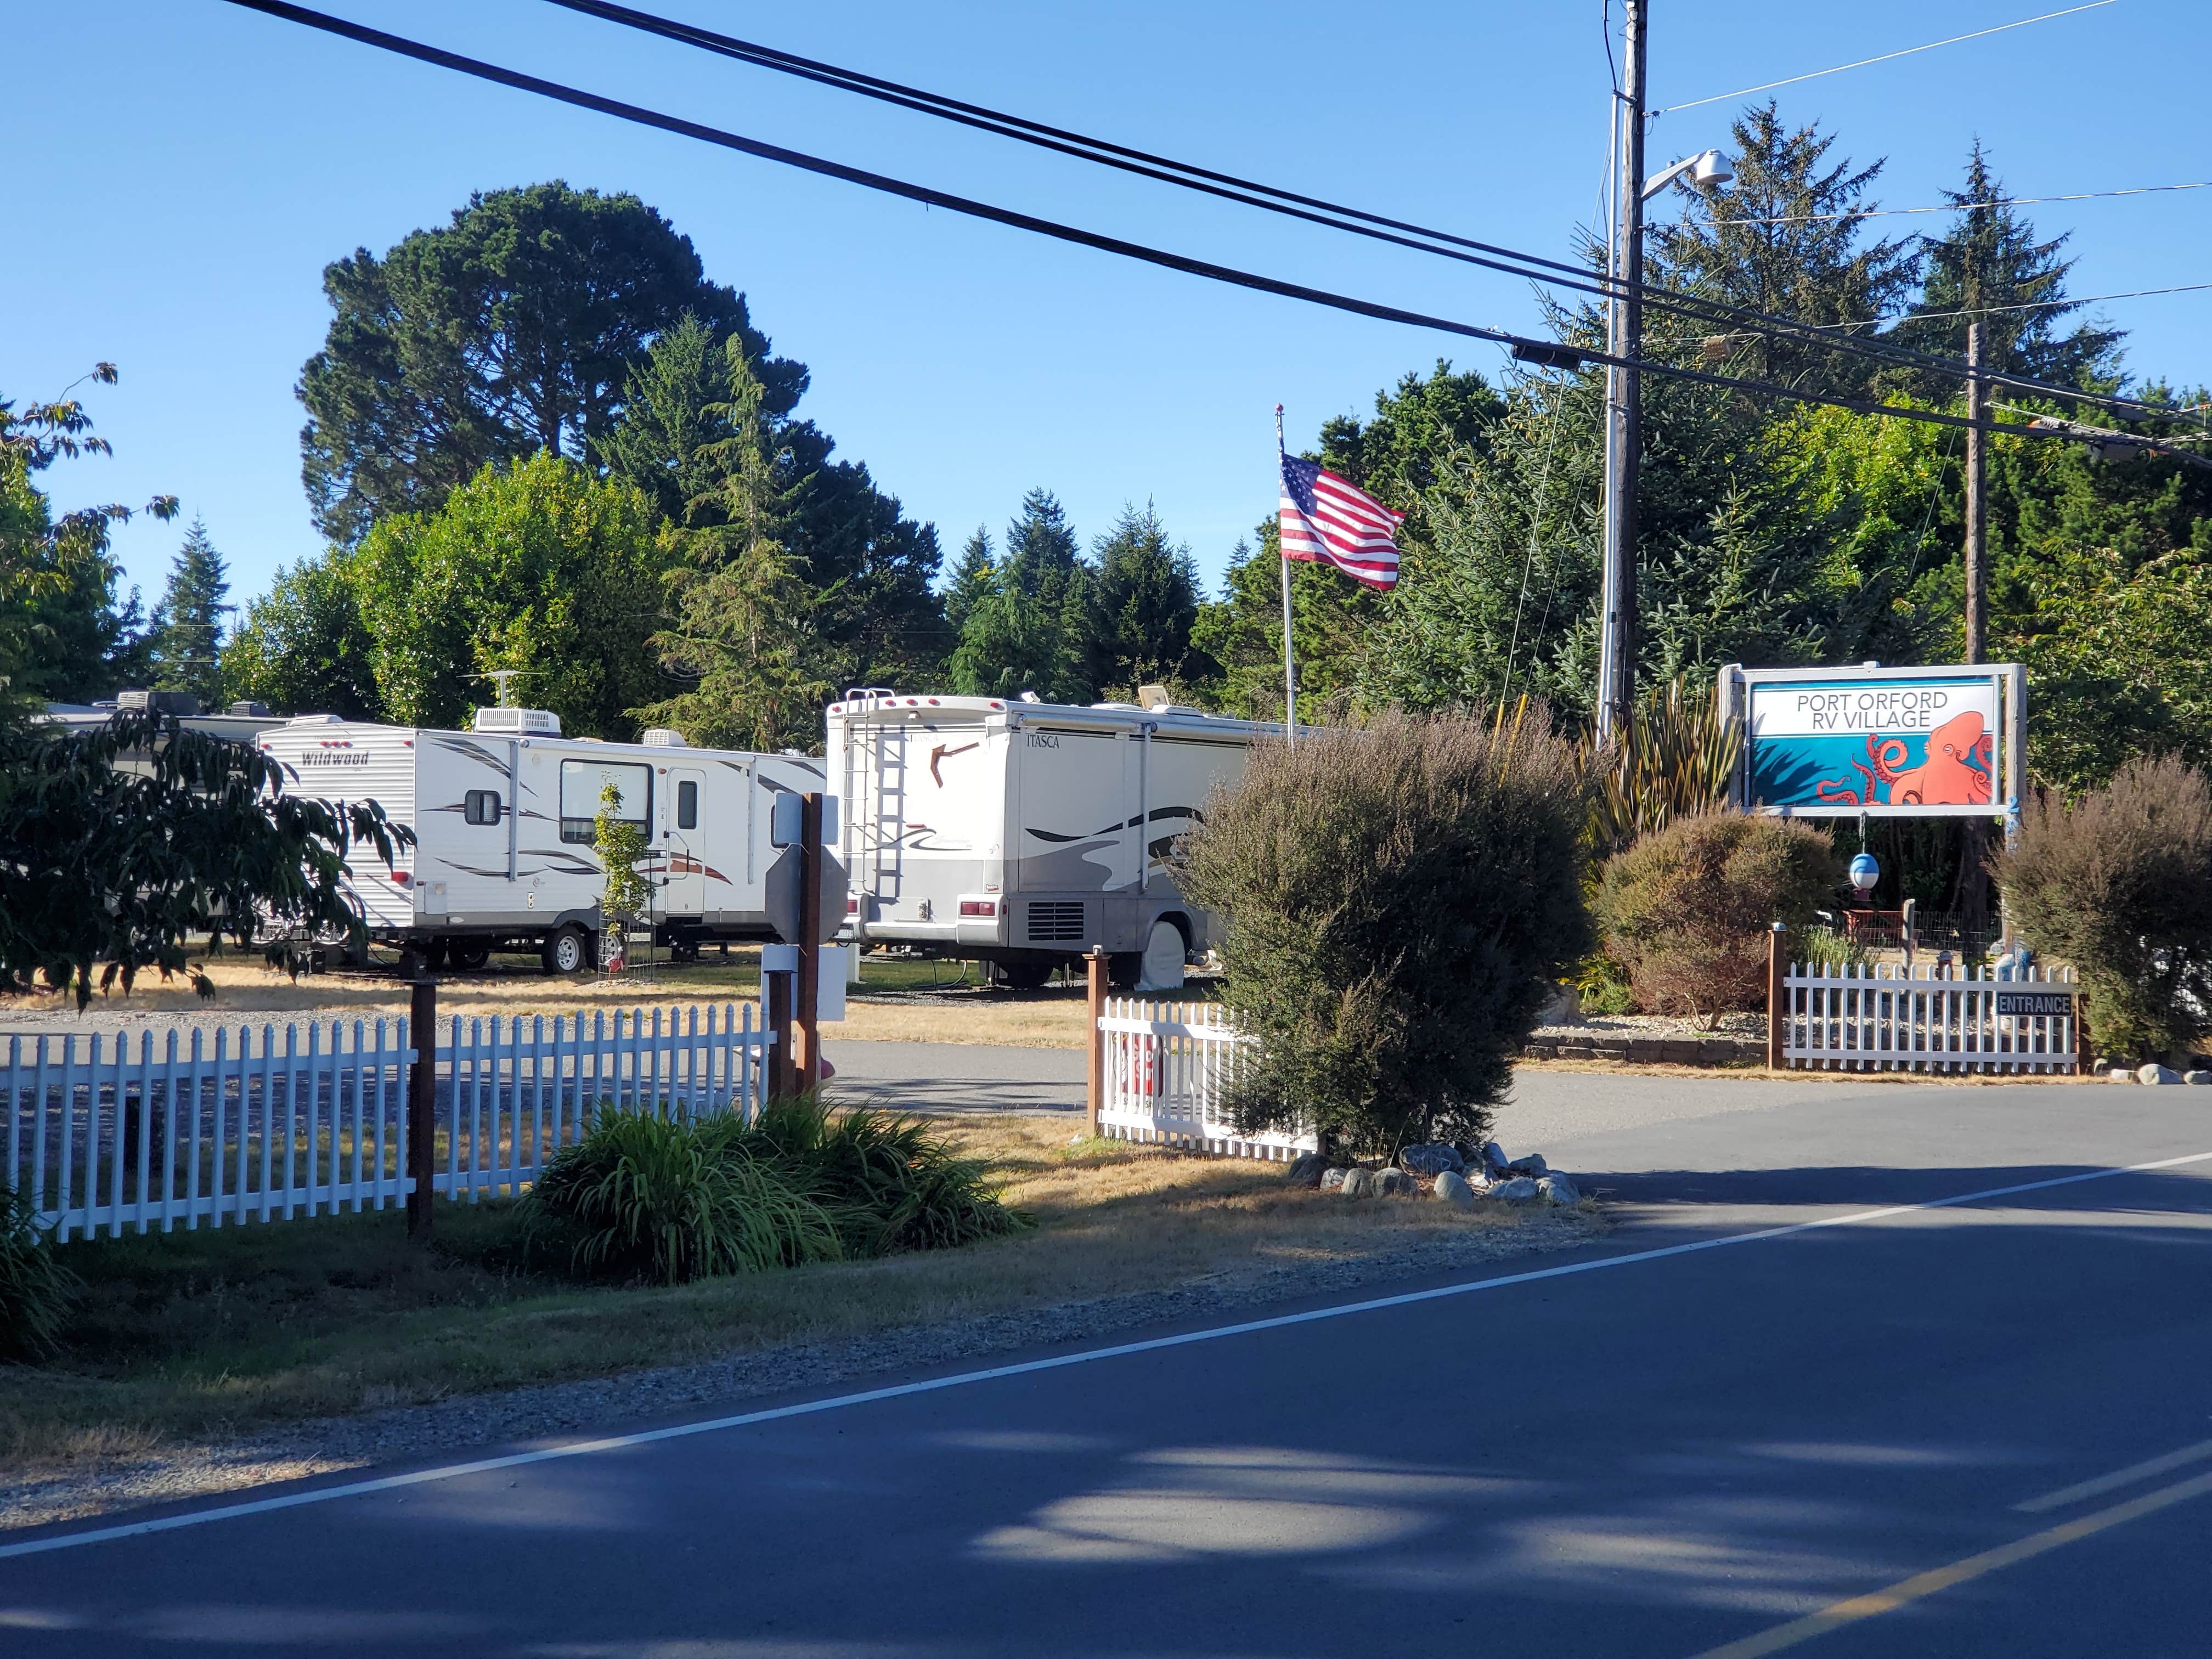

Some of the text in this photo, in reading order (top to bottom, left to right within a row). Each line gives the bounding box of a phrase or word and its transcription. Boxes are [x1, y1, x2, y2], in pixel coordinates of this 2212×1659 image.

[1798, 692, 1948, 712] PORT ORFORD
[1813, 710, 1931, 729] RV VILLAGE
[1026, 734, 1059, 748] ITASCA
[302, 751, 369, 765] Wildwood
[1999, 996, 2070, 1013] ENTRANCE
